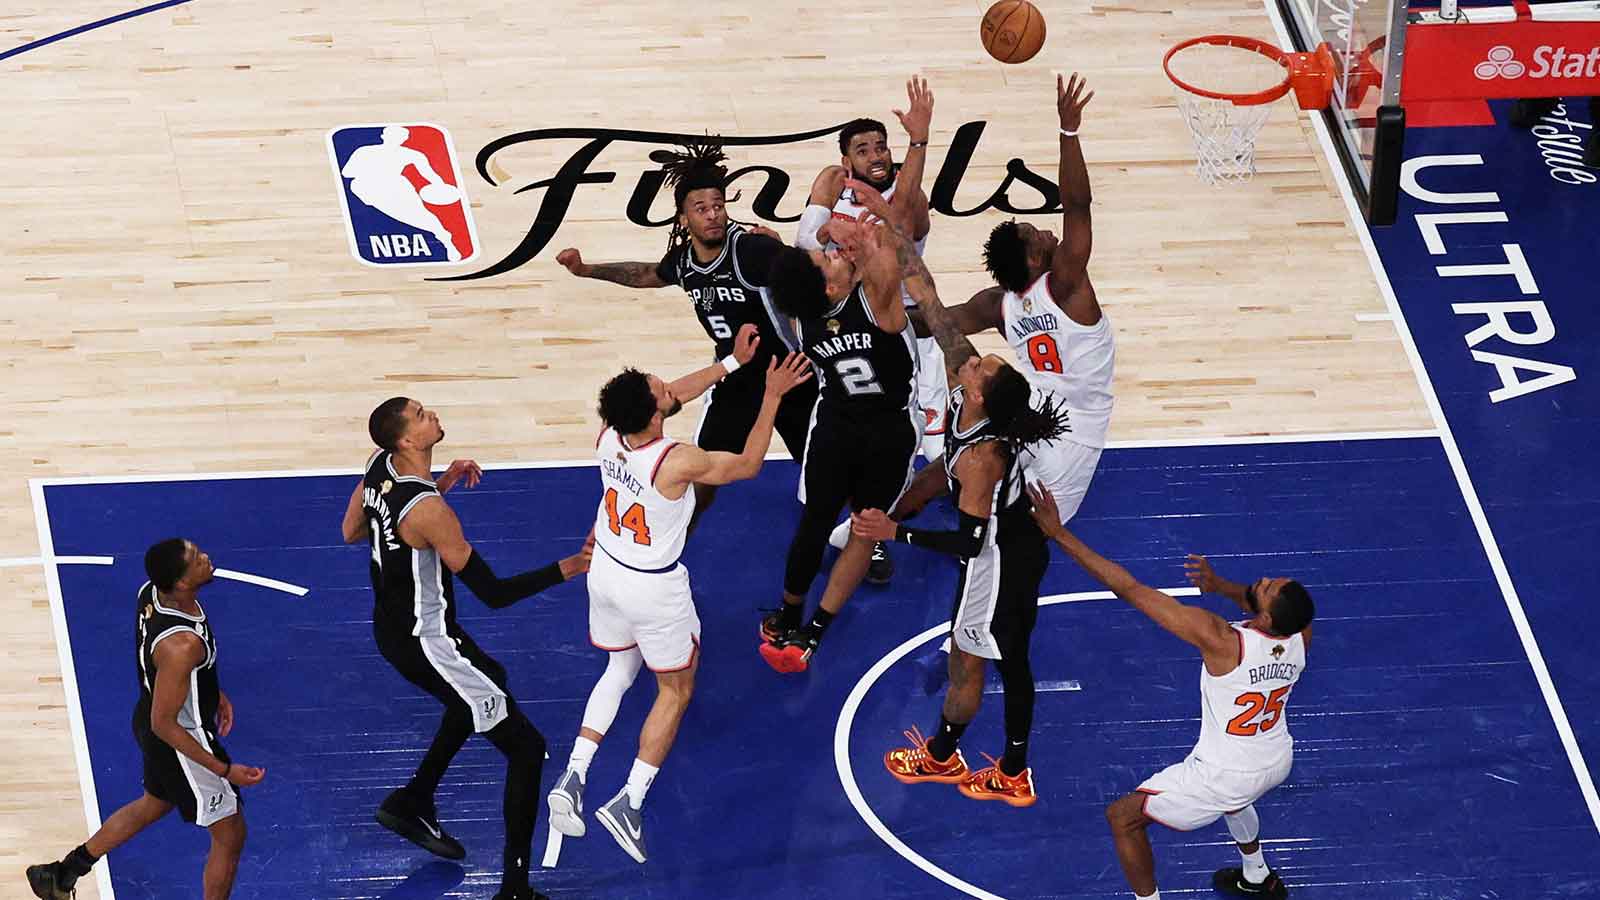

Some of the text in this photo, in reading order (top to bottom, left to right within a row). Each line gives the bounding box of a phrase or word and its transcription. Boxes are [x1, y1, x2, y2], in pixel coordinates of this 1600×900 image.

[1529, 45, 1600, 78] Stat
[424, 120, 1063, 281] Finls
[369, 233, 432, 258] NBA
[1400, 154, 1577, 403] ULTRA
[707, 315, 733, 339] 5
[812, 332, 873, 359] HARPER
[1026, 332, 1064, 375] 8
[834, 357, 886, 396] 2
[603, 459, 644, 496] SHAMET
[1248, 662, 1297, 684] BRIDGES
[1225, 683, 1293, 736] 25
